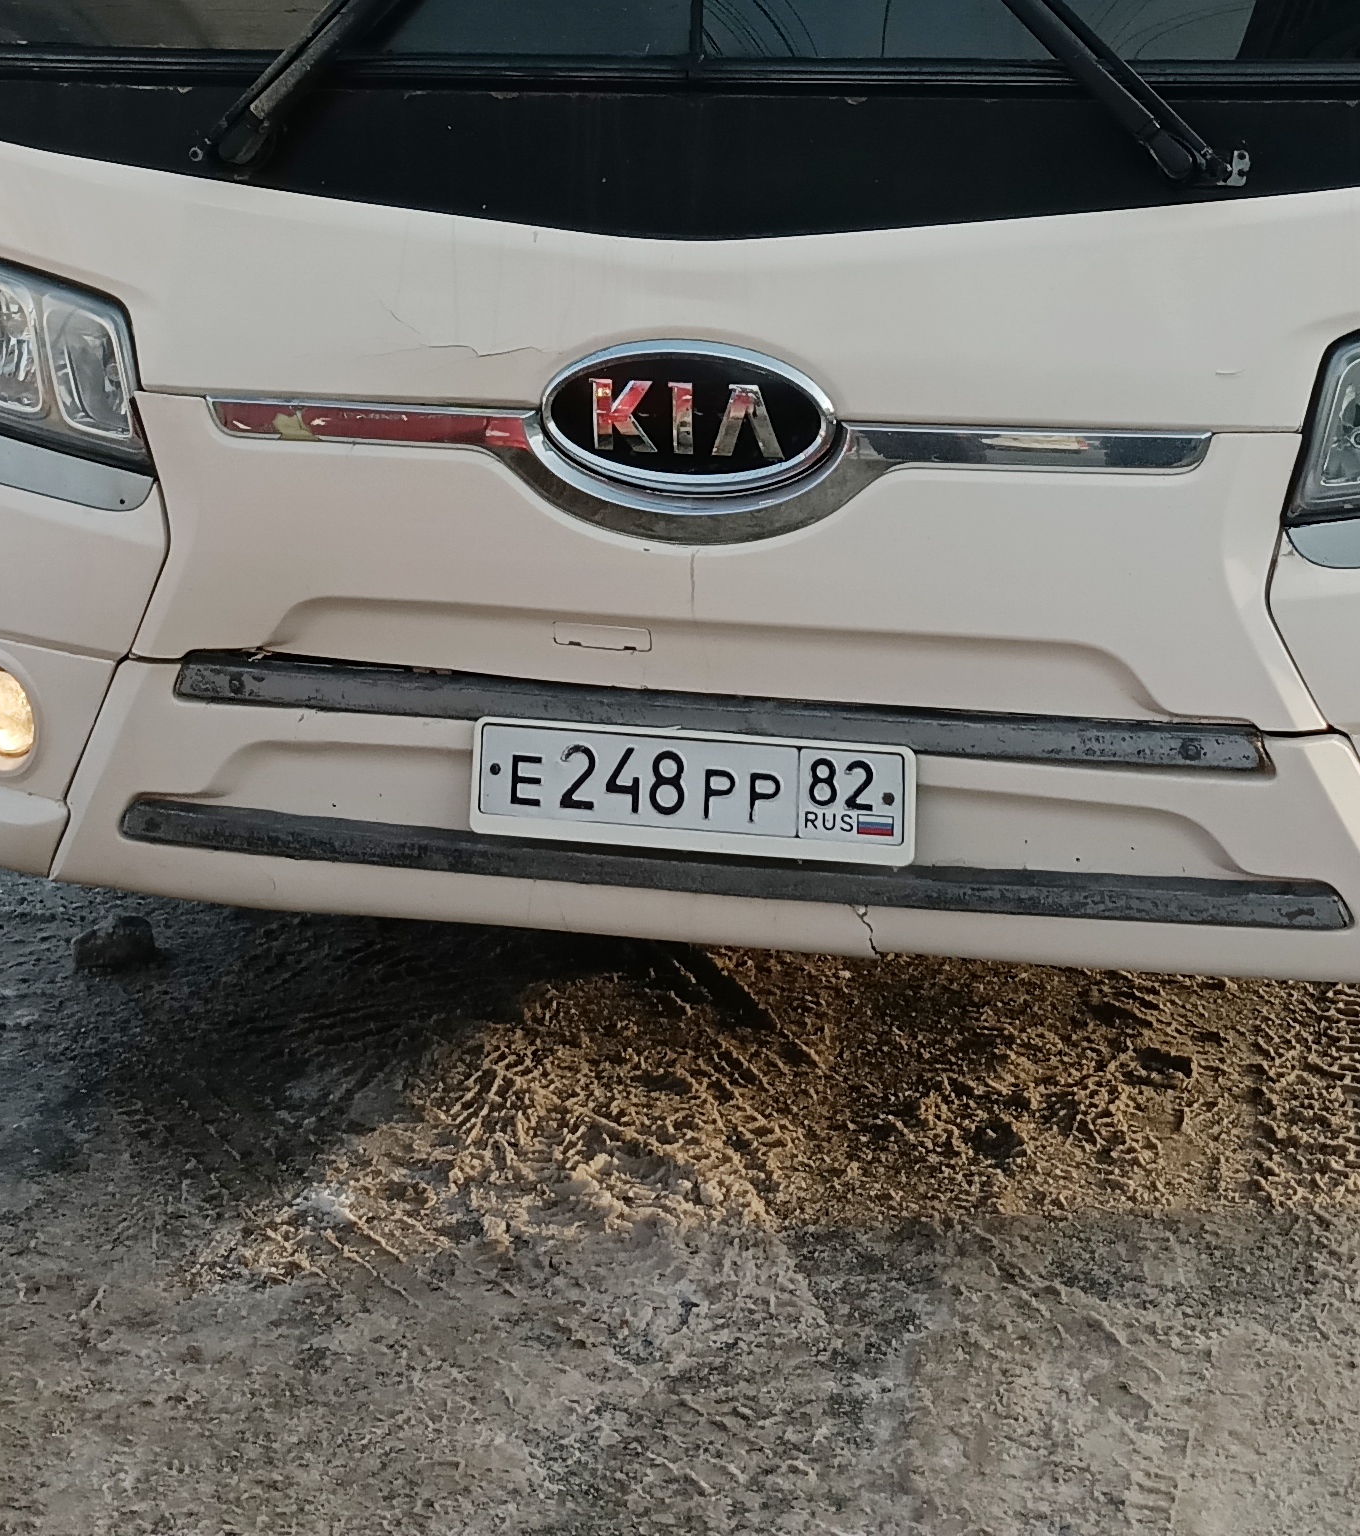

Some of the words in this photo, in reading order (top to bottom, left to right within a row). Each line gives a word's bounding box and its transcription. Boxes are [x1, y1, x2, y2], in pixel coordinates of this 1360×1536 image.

[589, 378, 785, 460] KIA
[809, 757, 874, 811] 82
[804, 810, 853, 833] RUS
